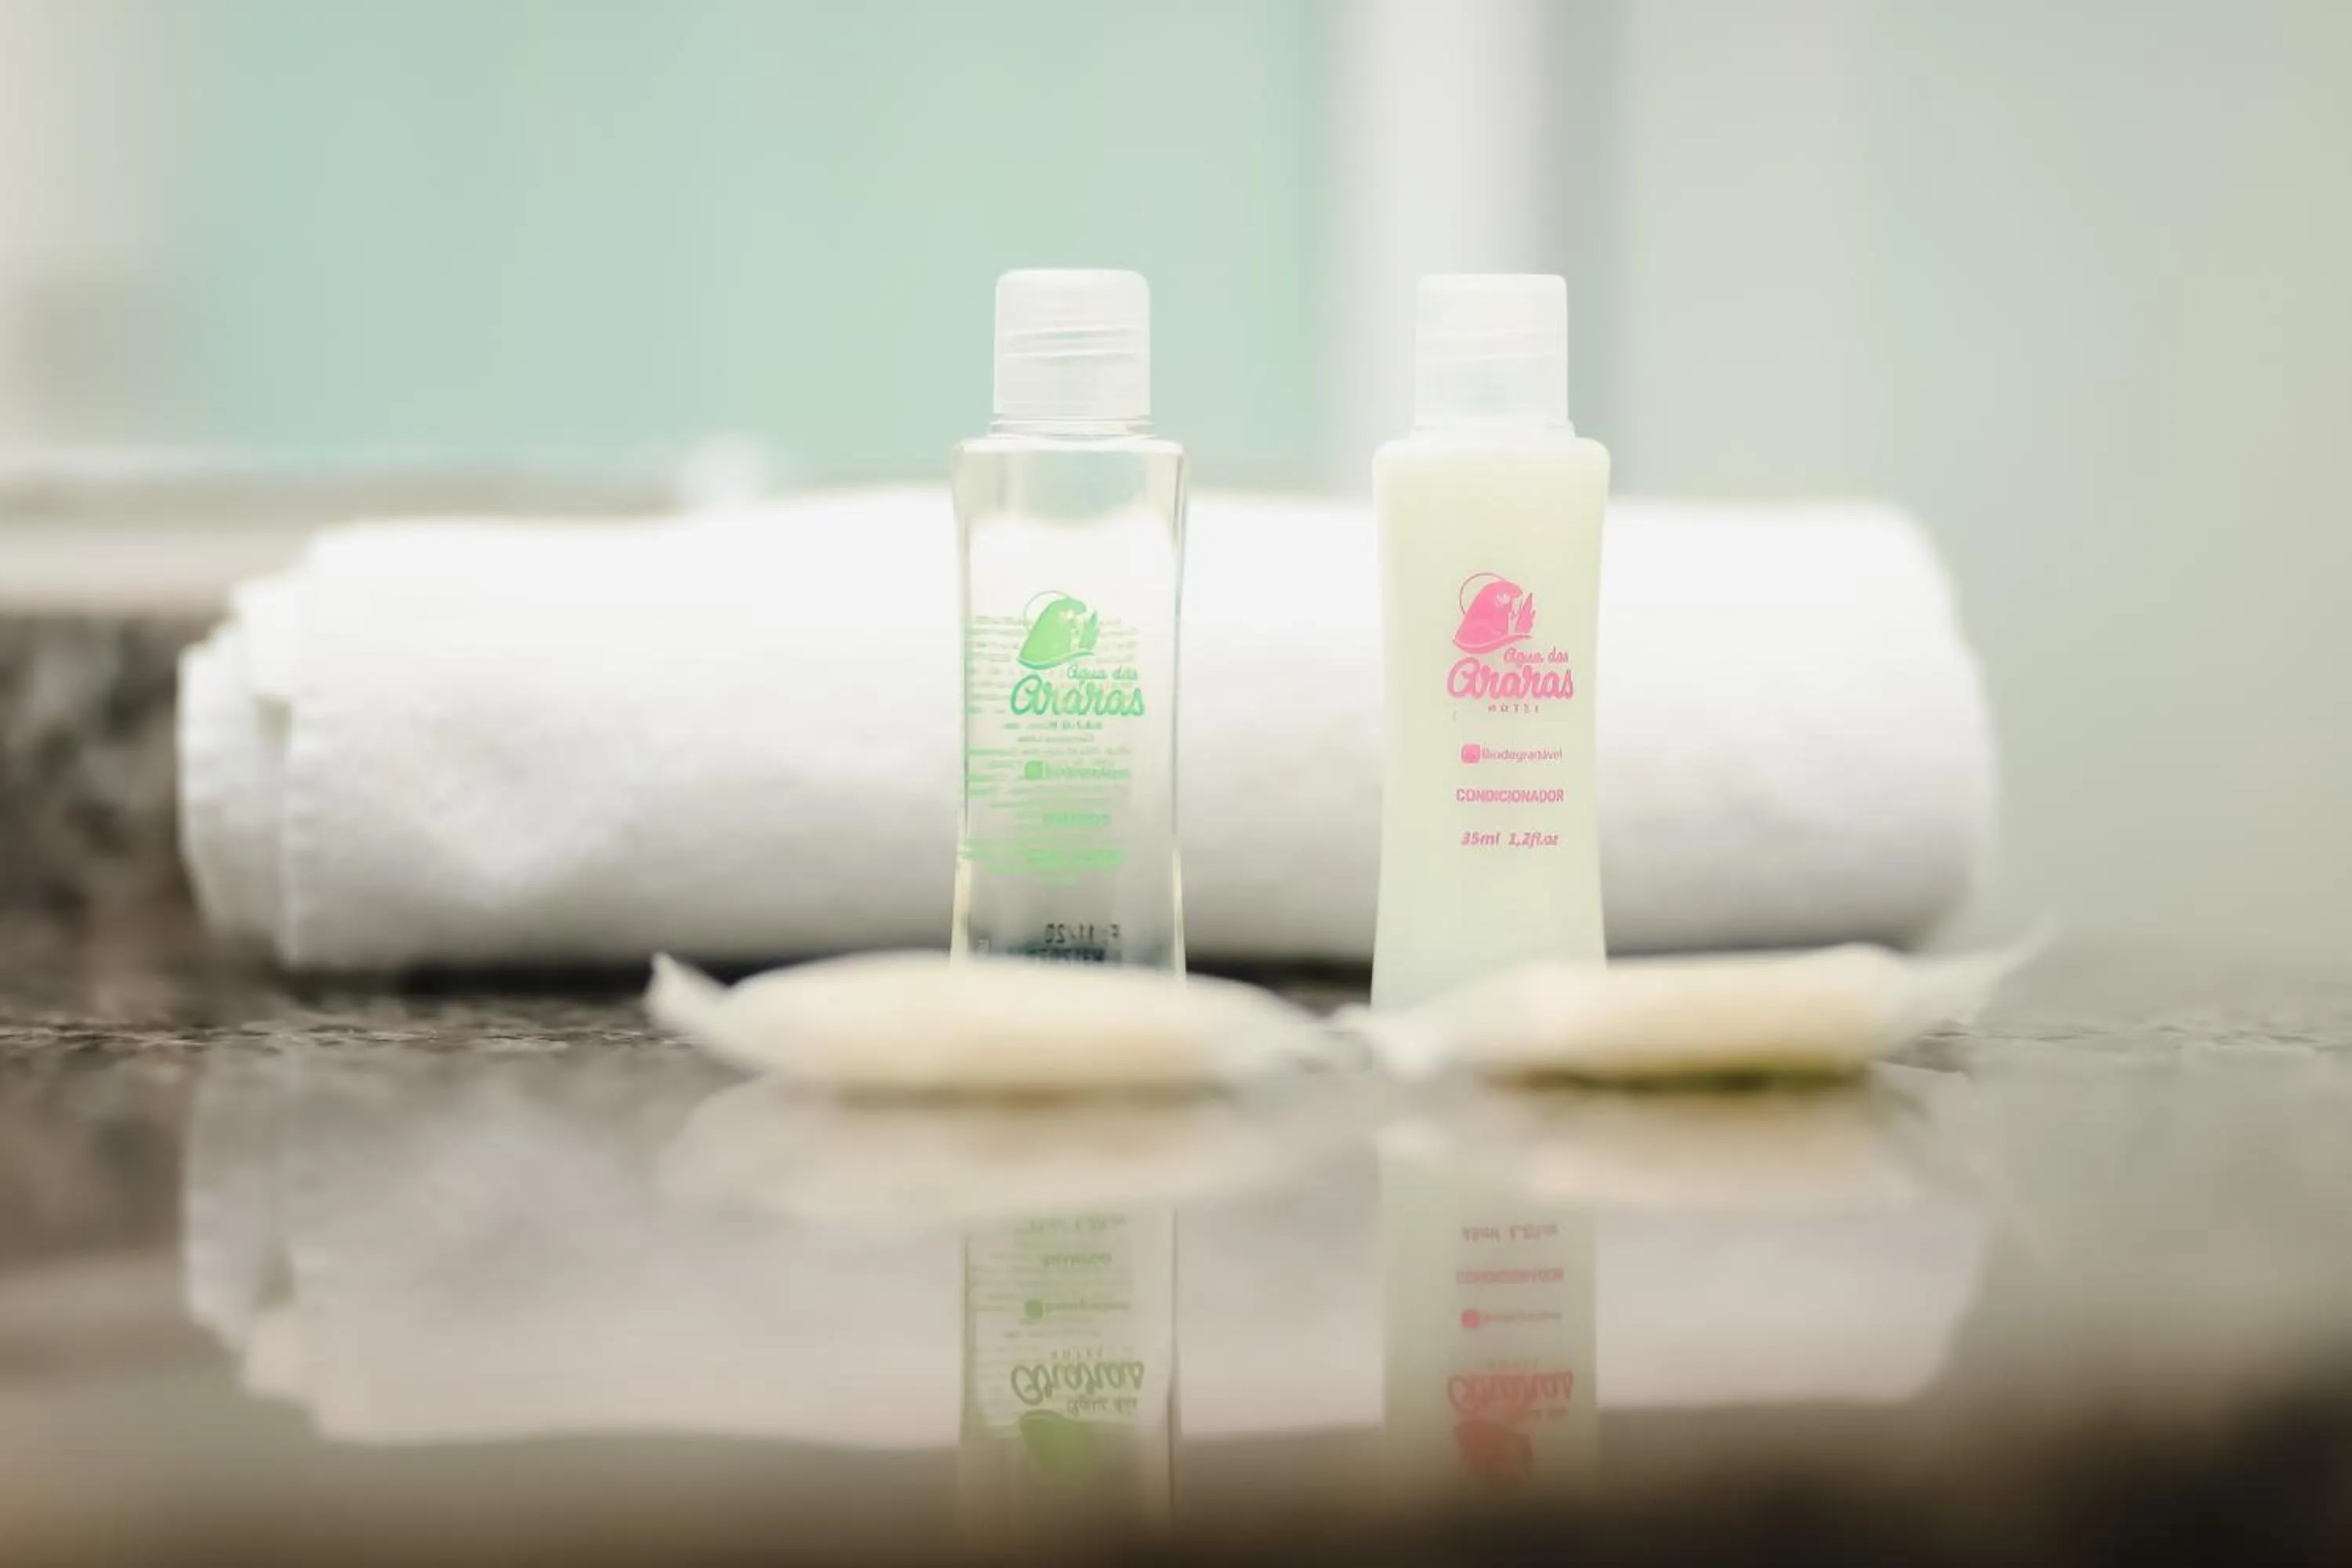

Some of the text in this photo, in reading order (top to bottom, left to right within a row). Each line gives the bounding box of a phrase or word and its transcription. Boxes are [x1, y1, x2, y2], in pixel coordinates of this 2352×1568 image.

[1447, 656, 1574, 700] Araras
[1009, 674, 1145, 716] Araras
[1456, 789, 1565, 804] CONDICIONADOR
[1461, 832, 1501, 847] 35ml
